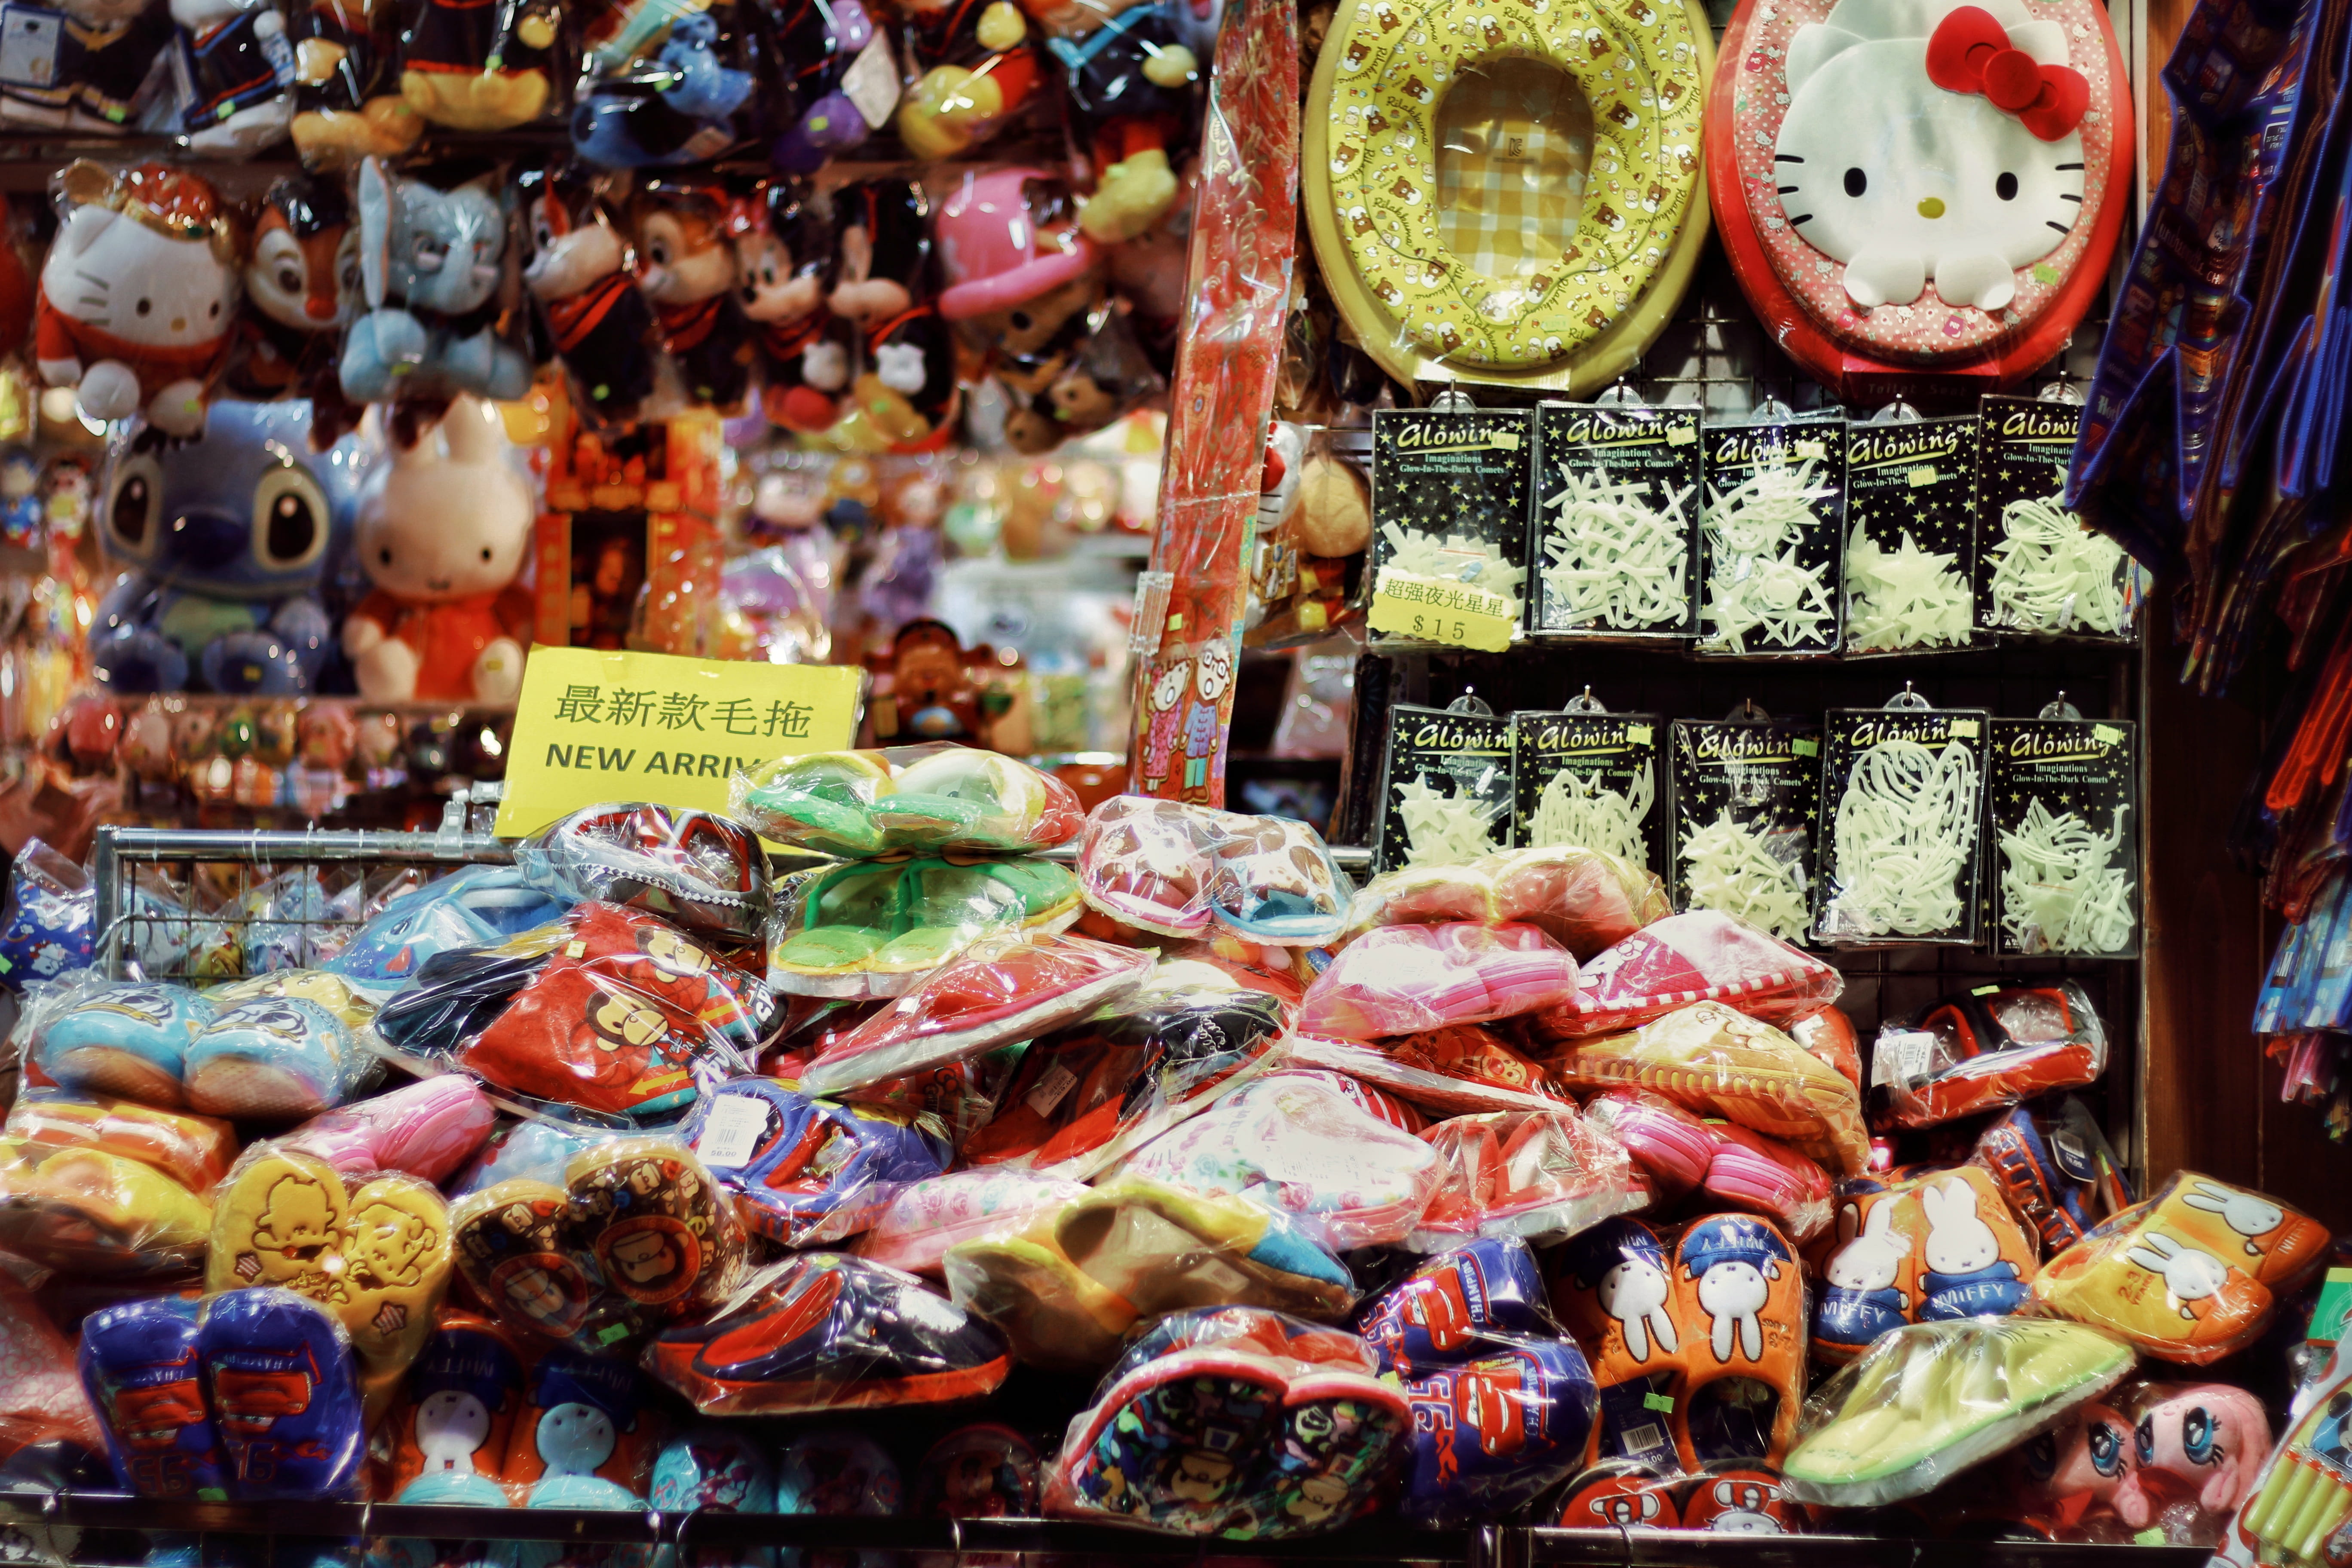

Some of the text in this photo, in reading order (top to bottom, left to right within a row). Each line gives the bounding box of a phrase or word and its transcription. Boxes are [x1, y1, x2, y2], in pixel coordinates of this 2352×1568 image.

[1386, 96, 1429, 147] Rilakkuma
[1373, 197, 1413, 248] Rilakkuma
[2003, 412, 2080, 436] Glowi
[1397, 423, 1507, 448] Glowin
[1594, 449, 1651, 459] Imaginations
[1848, 431, 1959, 464] Glowing
[2029, 443, 2074, 456] Imaginatio
[1425, 454, 1482, 464] Imaginations
[1568, 459, 1674, 468] Glow-In-The-Dark Comets
[1399, 464, 1504, 474] Glow-In-The-Dark Comets
[1383, 578, 1504, 618] 超强夜光星星
[554, 684, 814, 738] 最新款毛拖
[1414, 723, 1509, 749] Glowin
[546, 744, 761, 779] NEW ARRIV
[1561, 755, 1613, 768] Imaginations
[1608, 768, 1634, 778] Comets
[1724, 765, 1779, 776] Imaginations
[2035, 764, 2088, 774] Imaginations
[1773, 777, 1801, 787] Comets
[2012, 773, 2108, 784] Glow-In-The-Dark Comets
